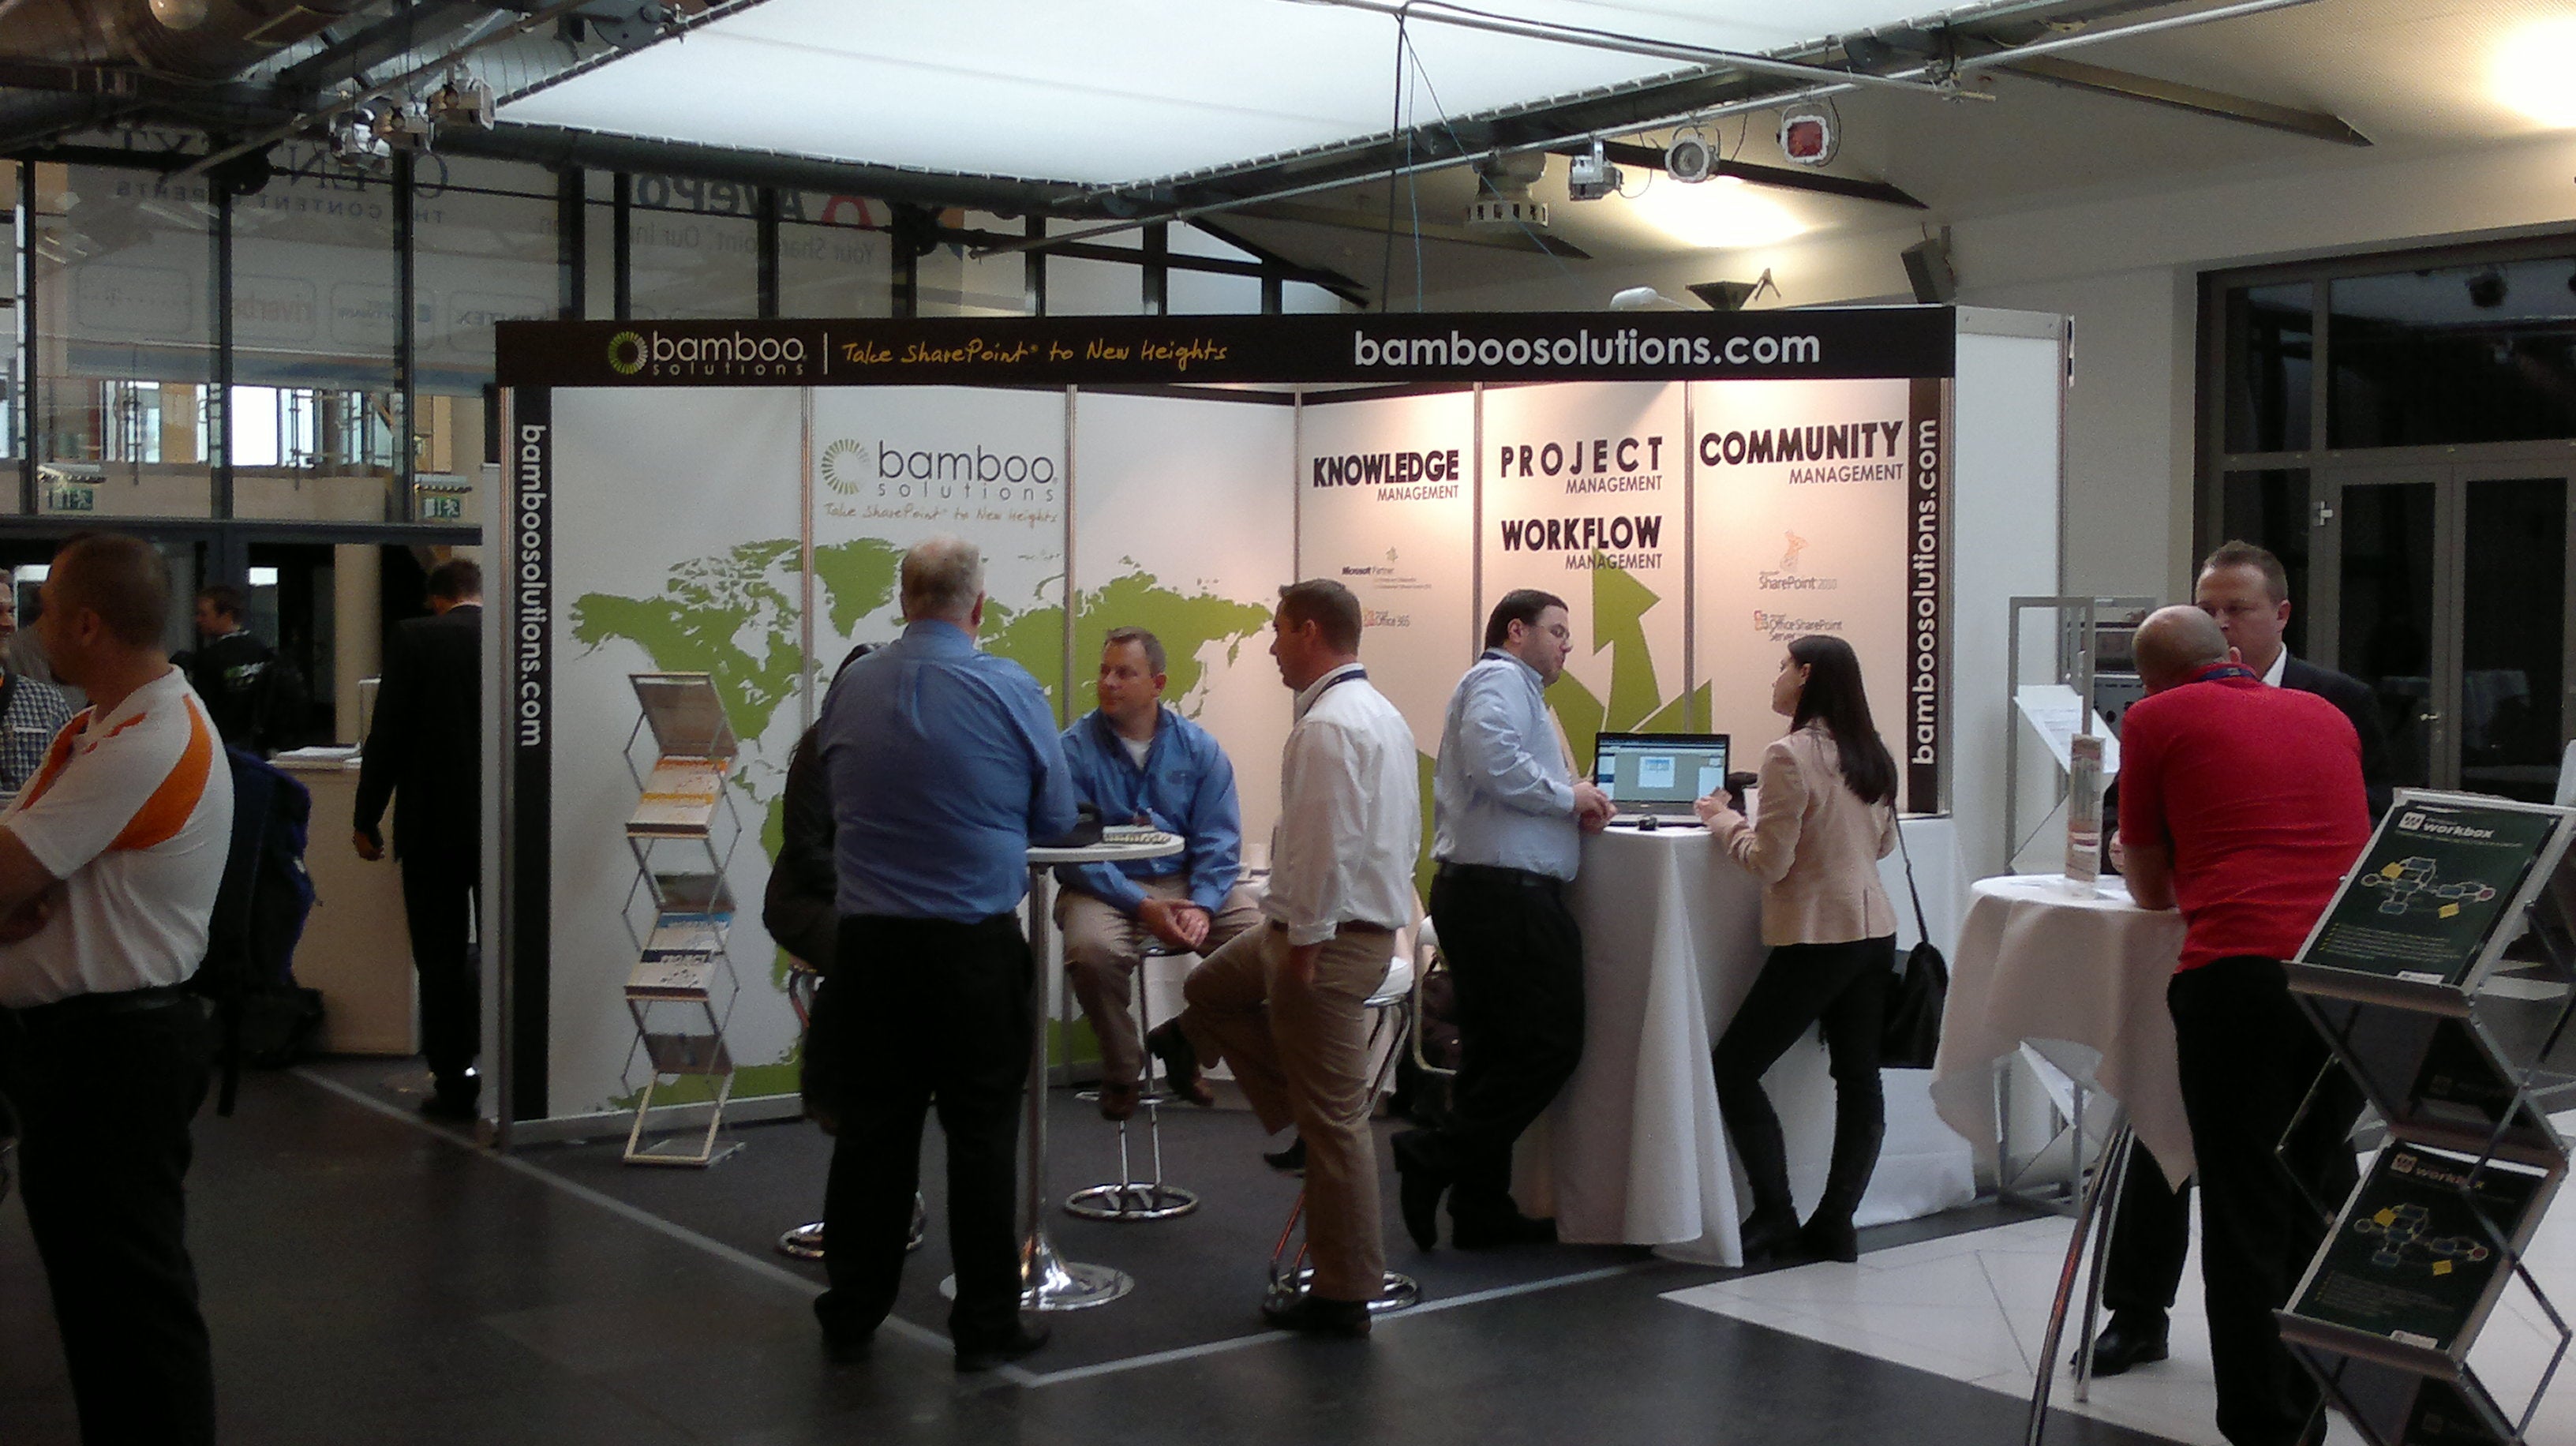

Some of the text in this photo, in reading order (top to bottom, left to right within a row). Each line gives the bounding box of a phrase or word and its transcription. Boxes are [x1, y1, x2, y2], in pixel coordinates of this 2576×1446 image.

[652, 330, 804, 362] bamboo
[841, 341, 893, 364] Take
[1049, 340, 1074, 362] to
[1086, 338, 1129, 361] New
[1140, 338, 1227, 371] Heights
[1354, 328, 1821, 366] bamboosolutions.com
[652, 362, 804, 376] solutions
[1699, 420, 1904, 466] COMMUNITY
[878, 439, 1054, 484] bamboo
[1312, 449, 1460, 488] KNOWLEDGE
[1500, 436, 1664, 478] PROJECT
[1565, 474, 1663, 495] MANAGEMENT
[1788, 463, 1904, 485] MANAGEMENT
[878, 481, 1054, 503] solutions
[1376, 484, 1459, 502] MANAGEMENT
[822, 502, 857, 518] Take
[975, 506, 1002, 521] New
[1501, 515, 1663, 552] WORKFLOW
[1564, 553, 1663, 571] MANAGEMENT
[520, 424, 548, 747] bamboosolutions.com
[1758, 575, 1817, 590] SharePoint
[1911, 419, 1938, 765] bamboosolutions.com
[2423, 822, 2496, 839] workbox
[2416, 1167, 2485, 1189] workx
